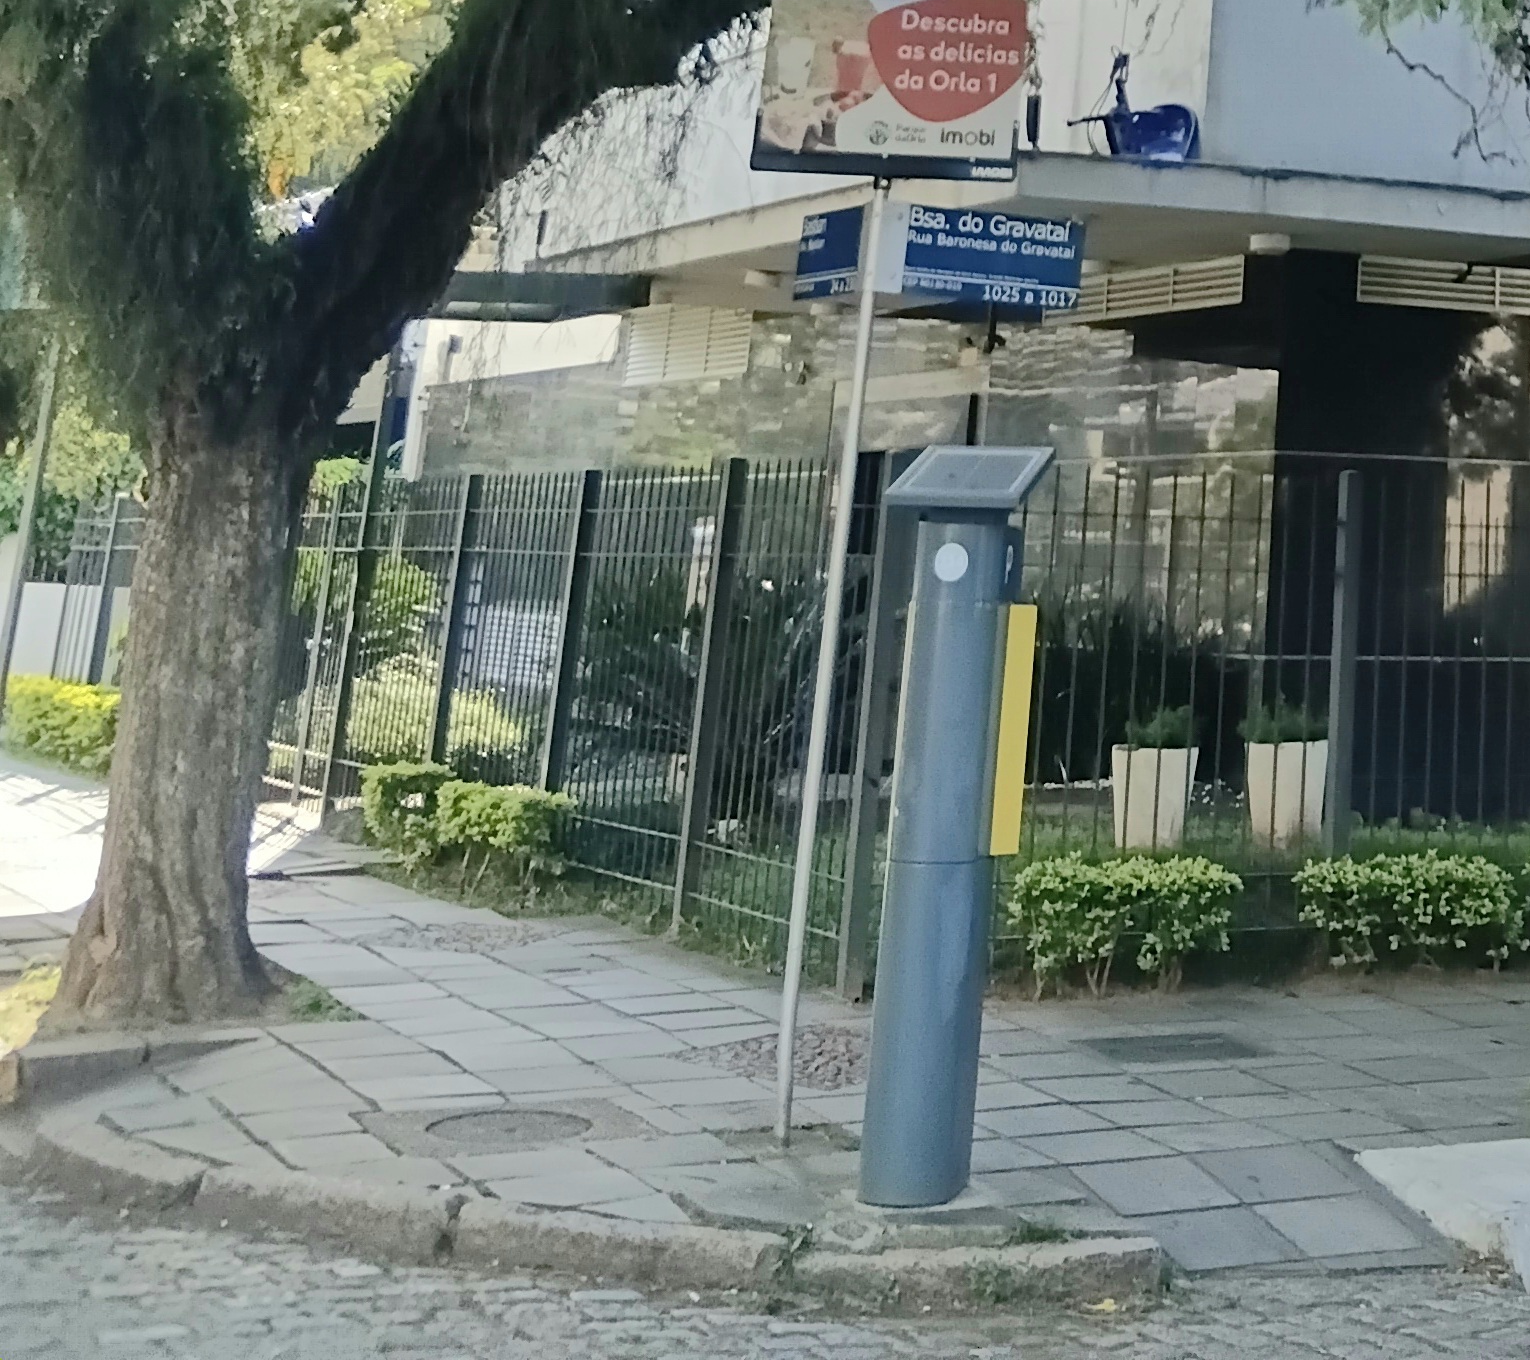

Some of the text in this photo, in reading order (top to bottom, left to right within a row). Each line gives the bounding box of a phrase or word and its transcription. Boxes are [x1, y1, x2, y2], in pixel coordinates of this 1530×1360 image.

[901, 8, 1010, 35] Descubra
[897, 44, 925, 60] as
[894, 68, 998, 93] da Orla 1
[940, 128, 995, 146] imobi
[910, 206, 1072, 242] Bsa. do Gravataí
[908, 230, 933, 245] Rua
[937, 234, 997, 252] Baronesa
[1001, 240, 1018, 254] do
[982, 285, 1021, 303] 1025
[1024, 291, 1034, 304] a
[1040, 290, 1077, 307] 1017
